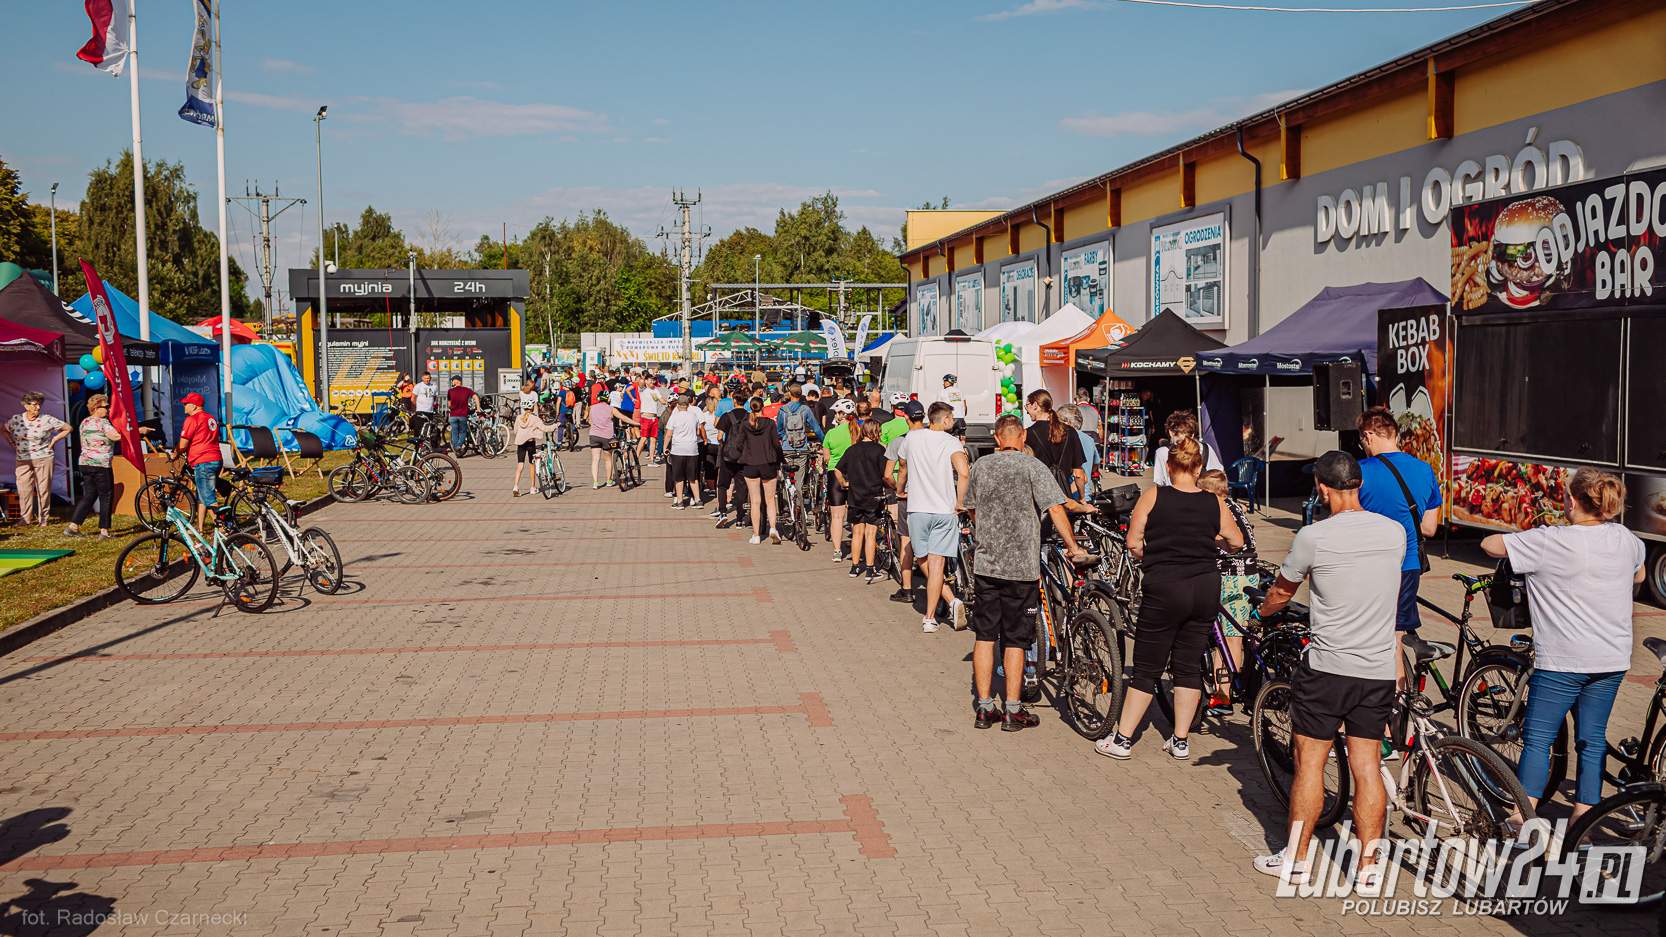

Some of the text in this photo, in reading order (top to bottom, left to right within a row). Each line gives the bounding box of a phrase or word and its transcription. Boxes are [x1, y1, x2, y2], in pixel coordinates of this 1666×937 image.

[1317, 127, 1585, 243] DOM I OGRÓD
[1185, 225, 1221, 244] OGRODZENIA
[340, 281, 486, 296] myjnia 24h
[1595, 246, 1654, 300] BAR
[1388, 314, 1440, 349] KEBAB
[1397, 344, 1430, 374] BOX
